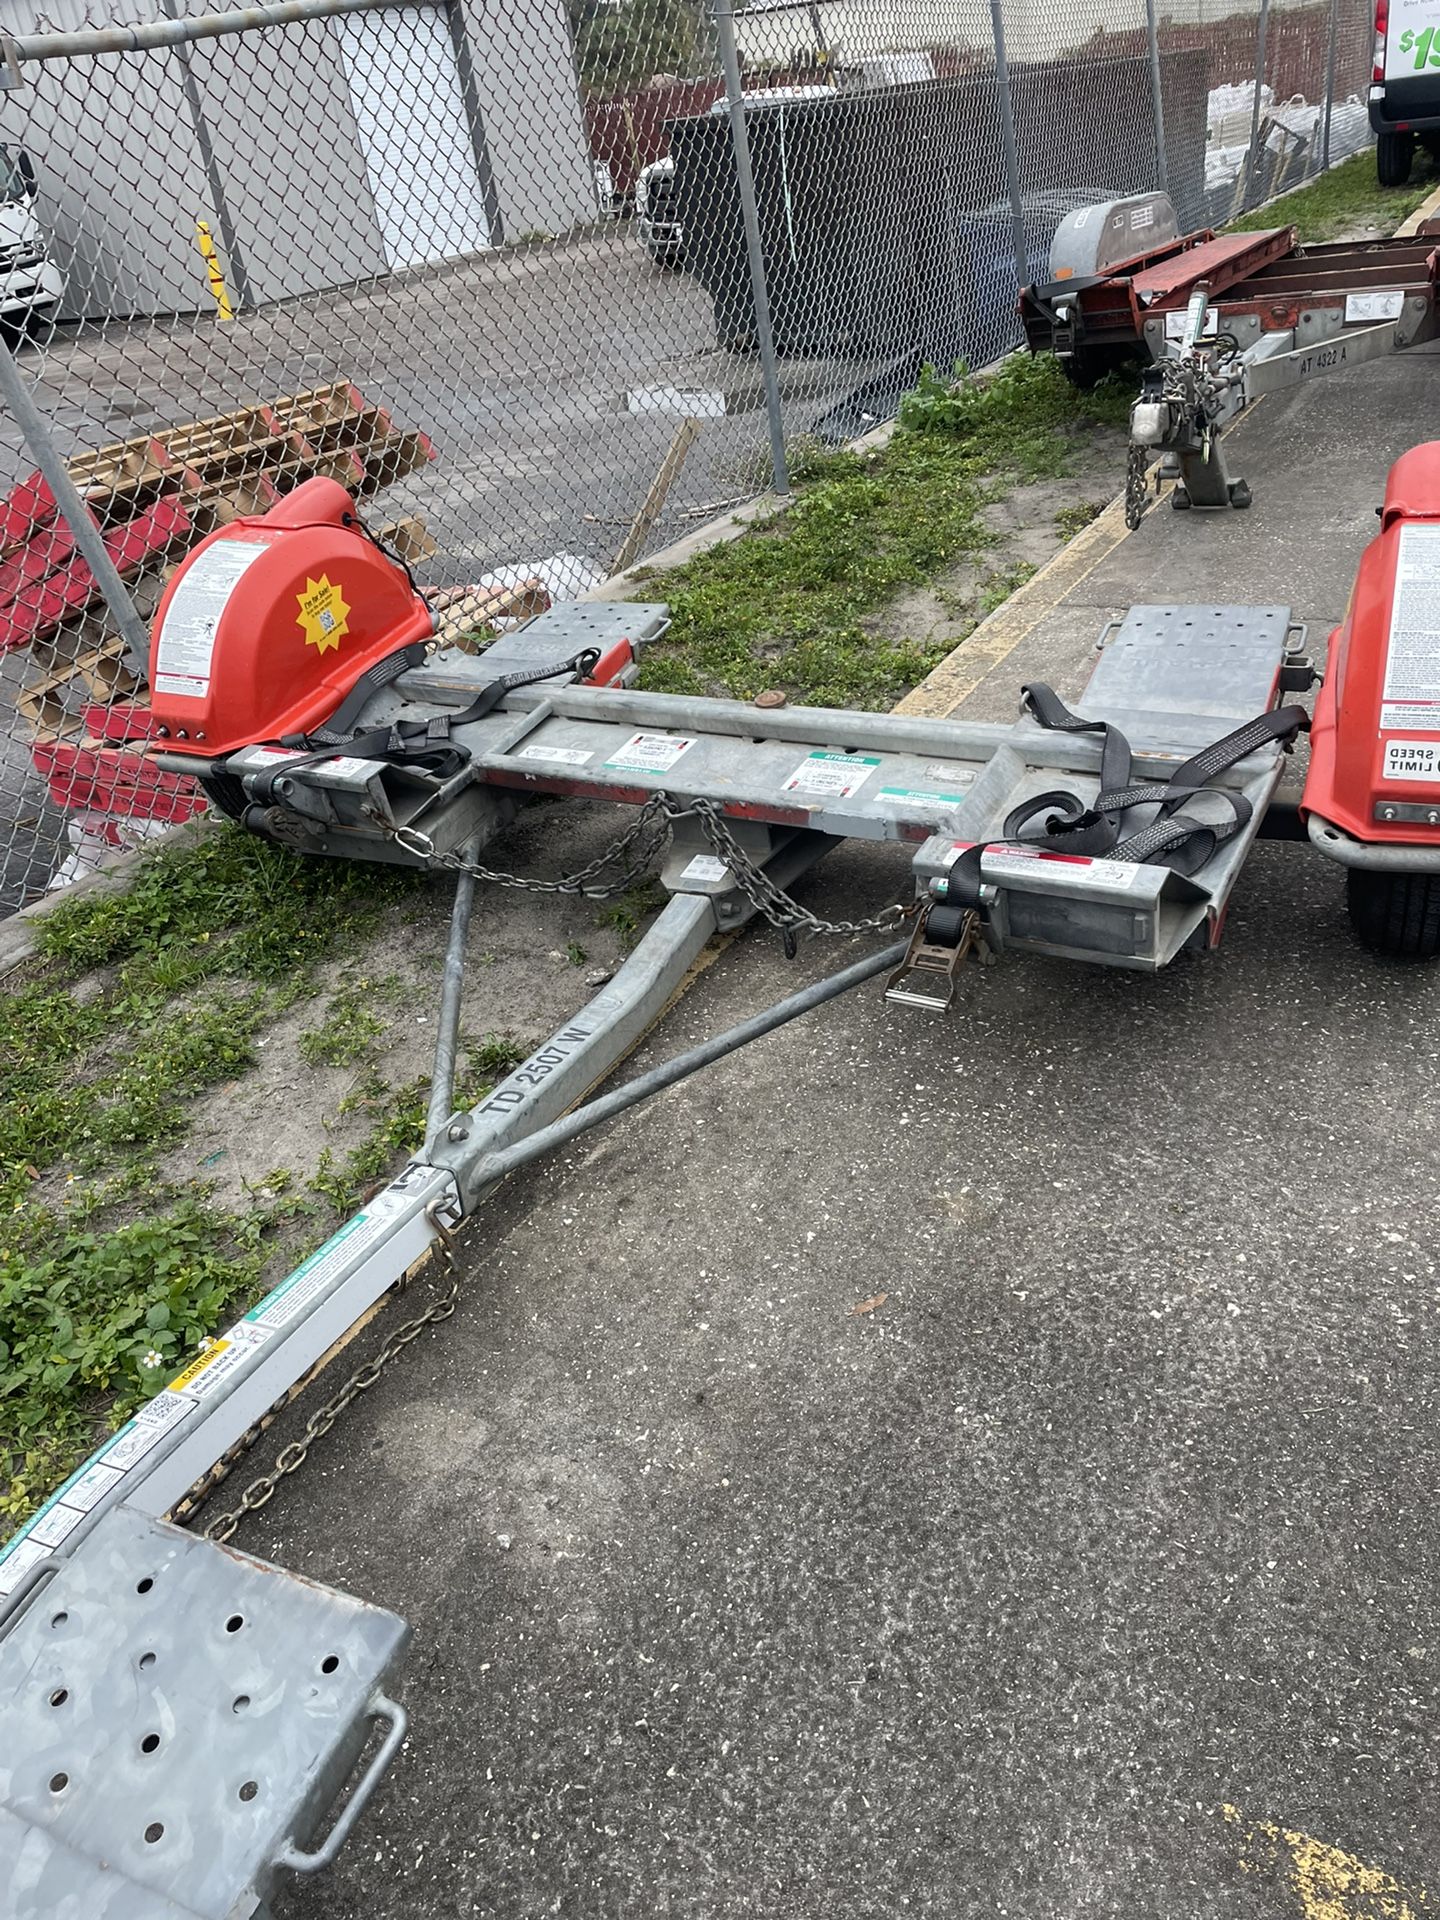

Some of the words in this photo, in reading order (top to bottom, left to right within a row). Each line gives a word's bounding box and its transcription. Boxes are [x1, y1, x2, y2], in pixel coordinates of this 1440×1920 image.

[1300, 357, 1313, 375] AT
[1316, 350, 1338, 369] 4322
[1340, 347, 1347, 361] A
[824, 753, 865, 763] ATTENTION
[479, 1090, 525, 1115] TD
[515, 1046, 571, 1086] 2507
[556, 1027, 592, 1044] W
[181, 1347, 219, 1380] CAUTION
[190, 1381, 202, 1389] DO
[199, 1370, 213, 1380] NOT
[211, 1355, 229, 1369] BACK
[195, 1372, 222, 1395] Damage
[219, 1362, 234, 1373] may
